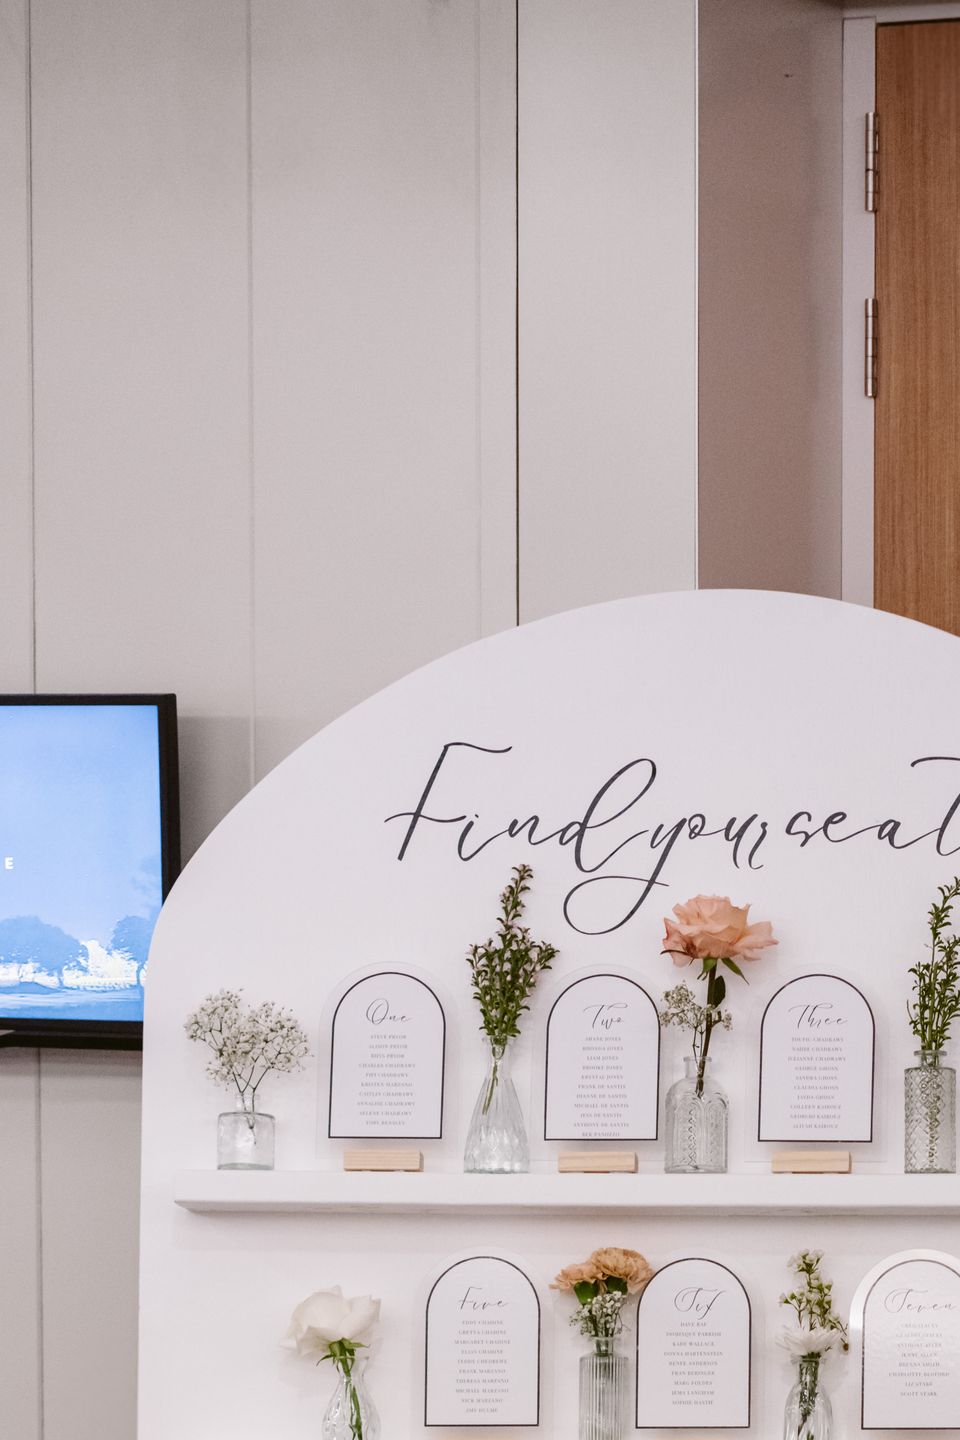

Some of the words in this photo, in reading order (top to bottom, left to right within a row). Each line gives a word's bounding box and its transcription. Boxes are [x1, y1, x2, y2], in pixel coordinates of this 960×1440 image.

[384, 741, 650, 873] Find
[562, 808, 764, 936] your
[583, 1003, 628, 1029] Two
[788, 1002, 848, 1028] Three
[457, 1286, 509, 1310] Five
[674, 1287, 726, 1320] Six
[884, 1288, 957, 1313] Seven
